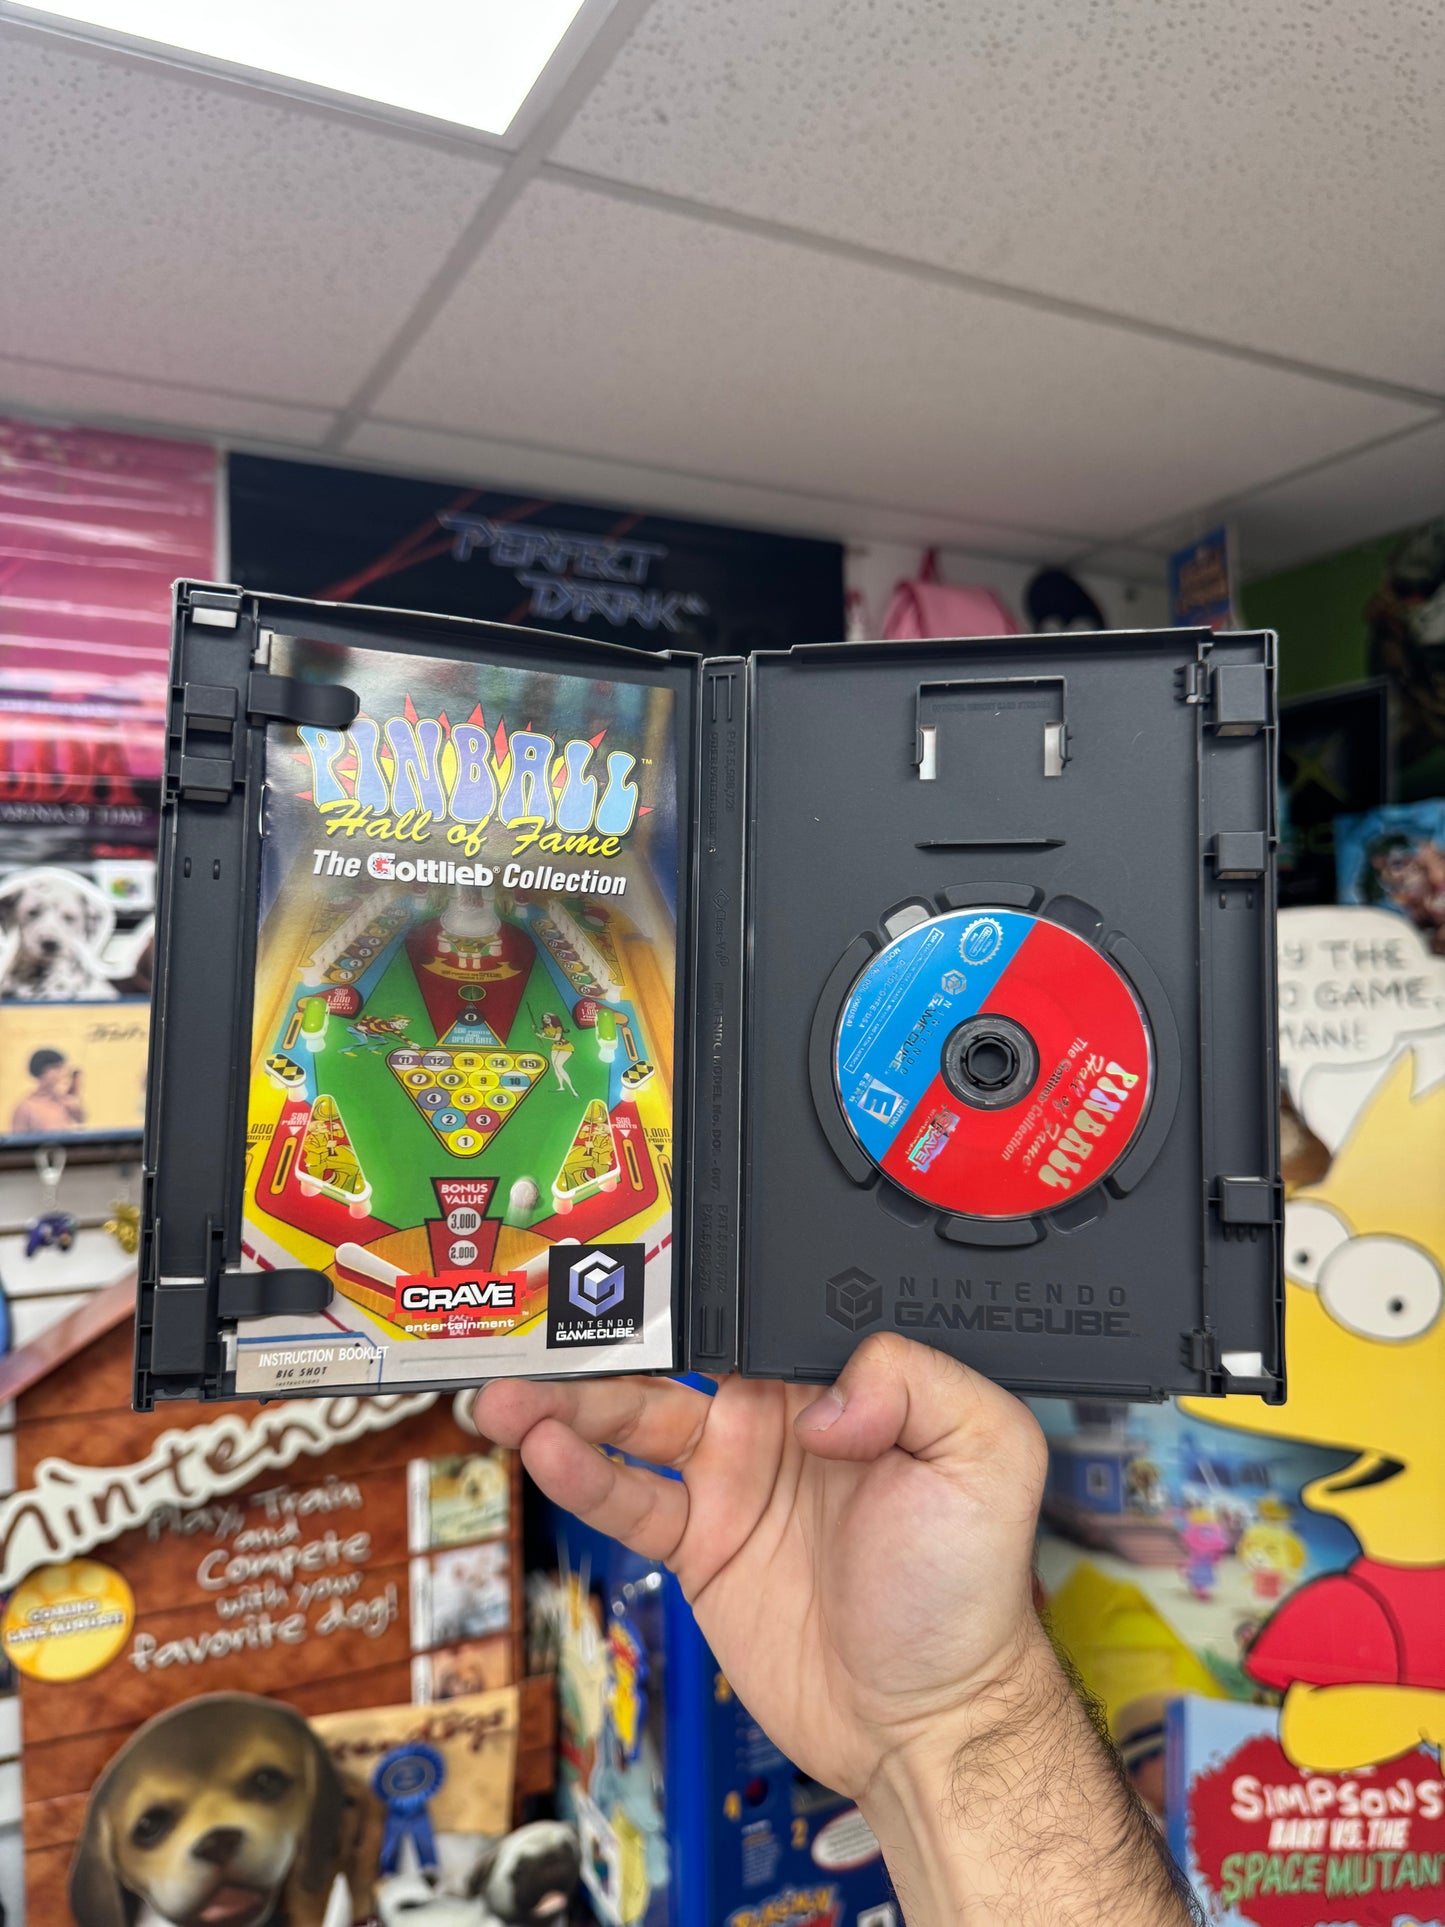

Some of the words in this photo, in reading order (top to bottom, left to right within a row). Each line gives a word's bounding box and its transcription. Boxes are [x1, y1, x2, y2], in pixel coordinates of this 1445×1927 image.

[437, 511, 668, 583] PERFECT
[515, 570, 690, 632] DARK
[298, 717, 639, 836] PINBALL
[319, 799, 431, 841] Hall
[447, 816, 489, 857] of
[506, 816, 621, 856] Fame
[313, 849, 360, 877] The
[502, 863, 627, 895] Collection
[888, 992, 944, 1072] GAMECUBE
[902, 999, 953, 1075] NINTENDO
[1068, 1037, 1088, 1059] The
[1076, 1053, 1105, 1098] Hall
[643, 1127, 671, 1138] 1,000
[1001, 1105, 1043, 1162] Collection
[1023, 1118, 1061, 1166] Fame
[1038, 1061, 1139, 1189] PINBALL
[441, 1183, 488, 1194] BONUS
[445, 1194, 485, 1204] VALUE
[450, 1213, 477, 1230] 3,000
[402, 1282, 514, 1311] CRAVE
[900, 1276, 1127, 1307] NINTENDO
[405, 1318, 515, 1333] entertainment
[556, 1327, 635, 1341] GAMECUBE
[558, 1318, 633, 1330] NINTENDO
[895, 1301, 1132, 1338] GAMECUBE
[259, 1348, 333, 1367] INSTRUCTION
[338, 1345, 389, 1361] BOOKLET
[276, 1369, 294, 1378] BIG
[299, 1366, 327, 1377] SHOT
[252, 1475, 363, 1521] Train
[233, 1516, 301, 1551] and
[196, 1529, 371, 1592] Compete
[215, 1578, 289, 1620] with
[293, 1571, 364, 1612] your
[128, 1612, 307, 1673] favorite
[1230, 1774, 1444, 1823] SIMPSONS
[1366, 1818, 1412, 1850] THE
[1221, 1852, 1324, 1904] SPACE
